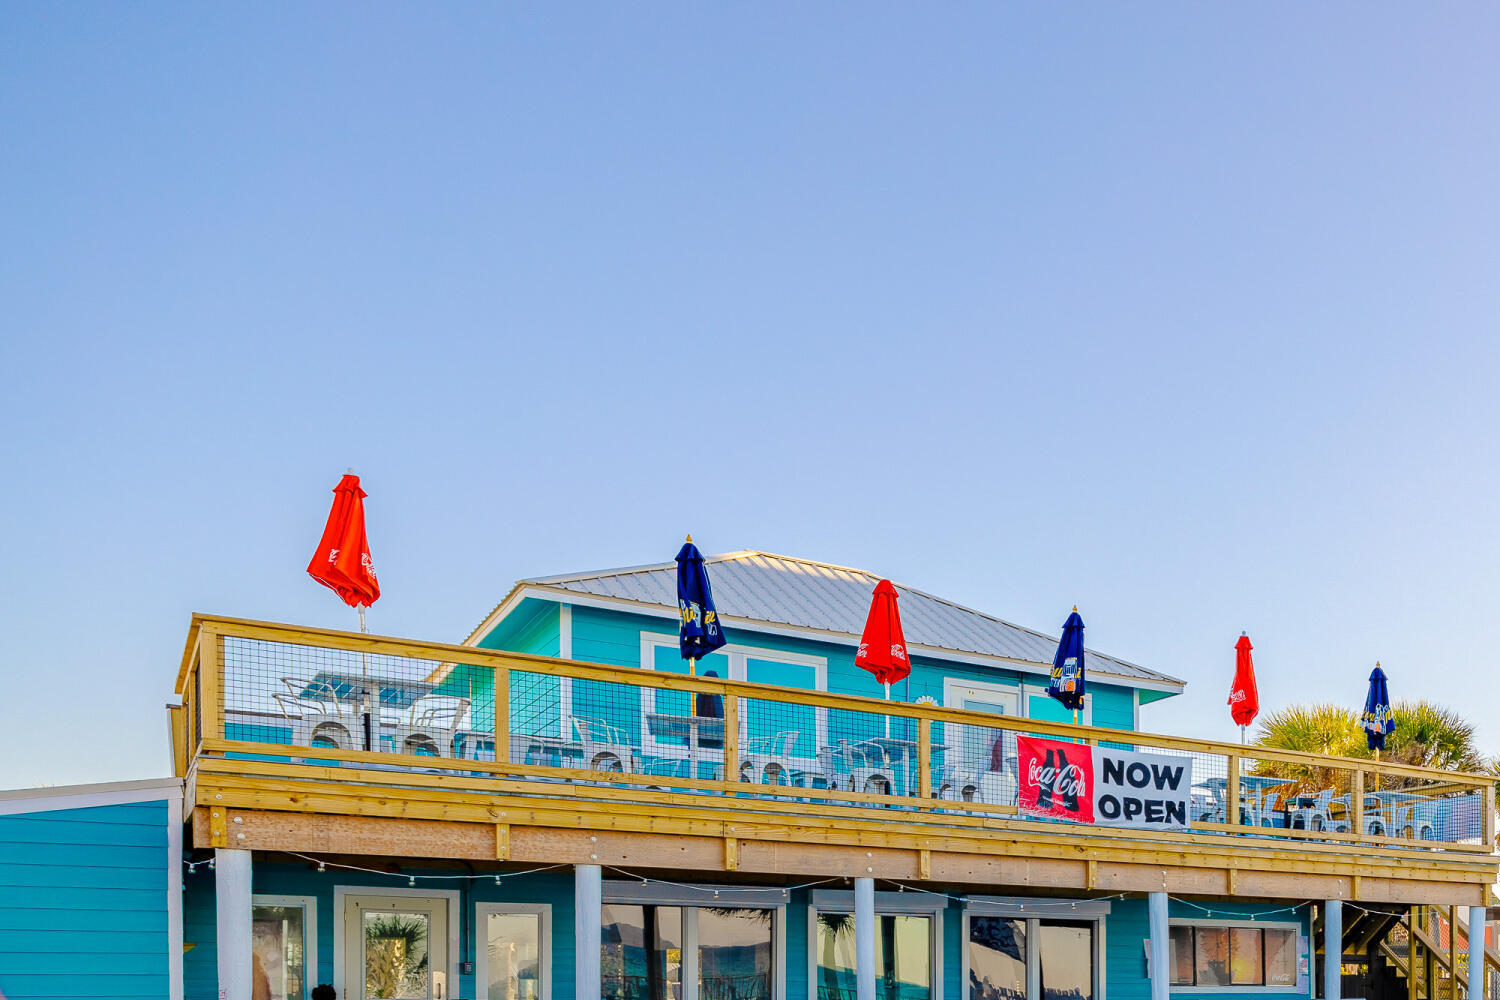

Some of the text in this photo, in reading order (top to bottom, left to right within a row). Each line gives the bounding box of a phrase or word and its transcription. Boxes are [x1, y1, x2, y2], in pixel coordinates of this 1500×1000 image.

[1028, 757, 1086, 797] Coca-Cola
[1102, 757, 1184, 791] NOW
[1098, 794, 1186, 825] OPEN
